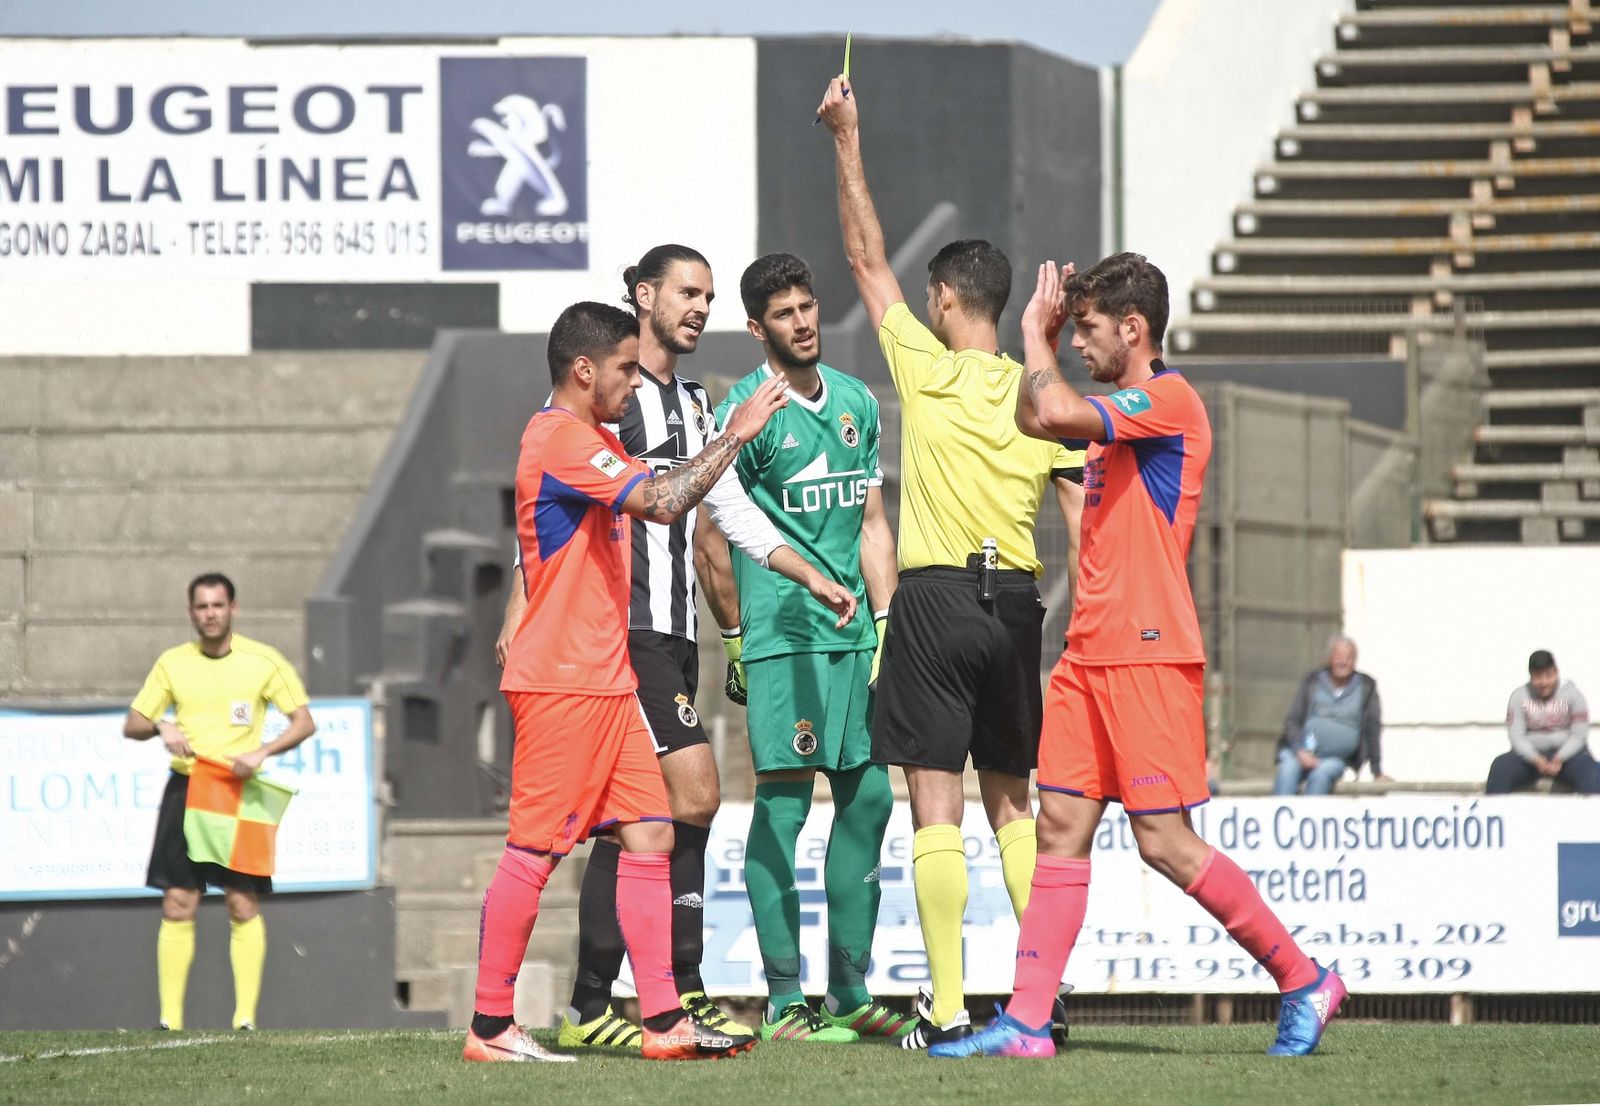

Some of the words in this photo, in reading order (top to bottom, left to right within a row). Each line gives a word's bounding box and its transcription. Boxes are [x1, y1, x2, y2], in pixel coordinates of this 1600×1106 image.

[98, 157, 183, 203] LA
[213, 143, 420, 202] LÍNEA
[80, 222, 162, 256] ZABAL
[187, 221, 270, 255] TELEF:
[280, 221, 322, 255] 956
[333, 221, 375, 255] 645
[387, 221, 427, 255] 015
[782, 478, 869, 513] LOTUS
[1220, 806, 1262, 850] de
[1274, 799, 1504, 850] Construcción
[673, 898, 704, 909] adida
[1433, 922, 1507, 946] 202
[1094, 957, 1176, 981] Tlf:
[1391, 957, 1473, 981] 309
